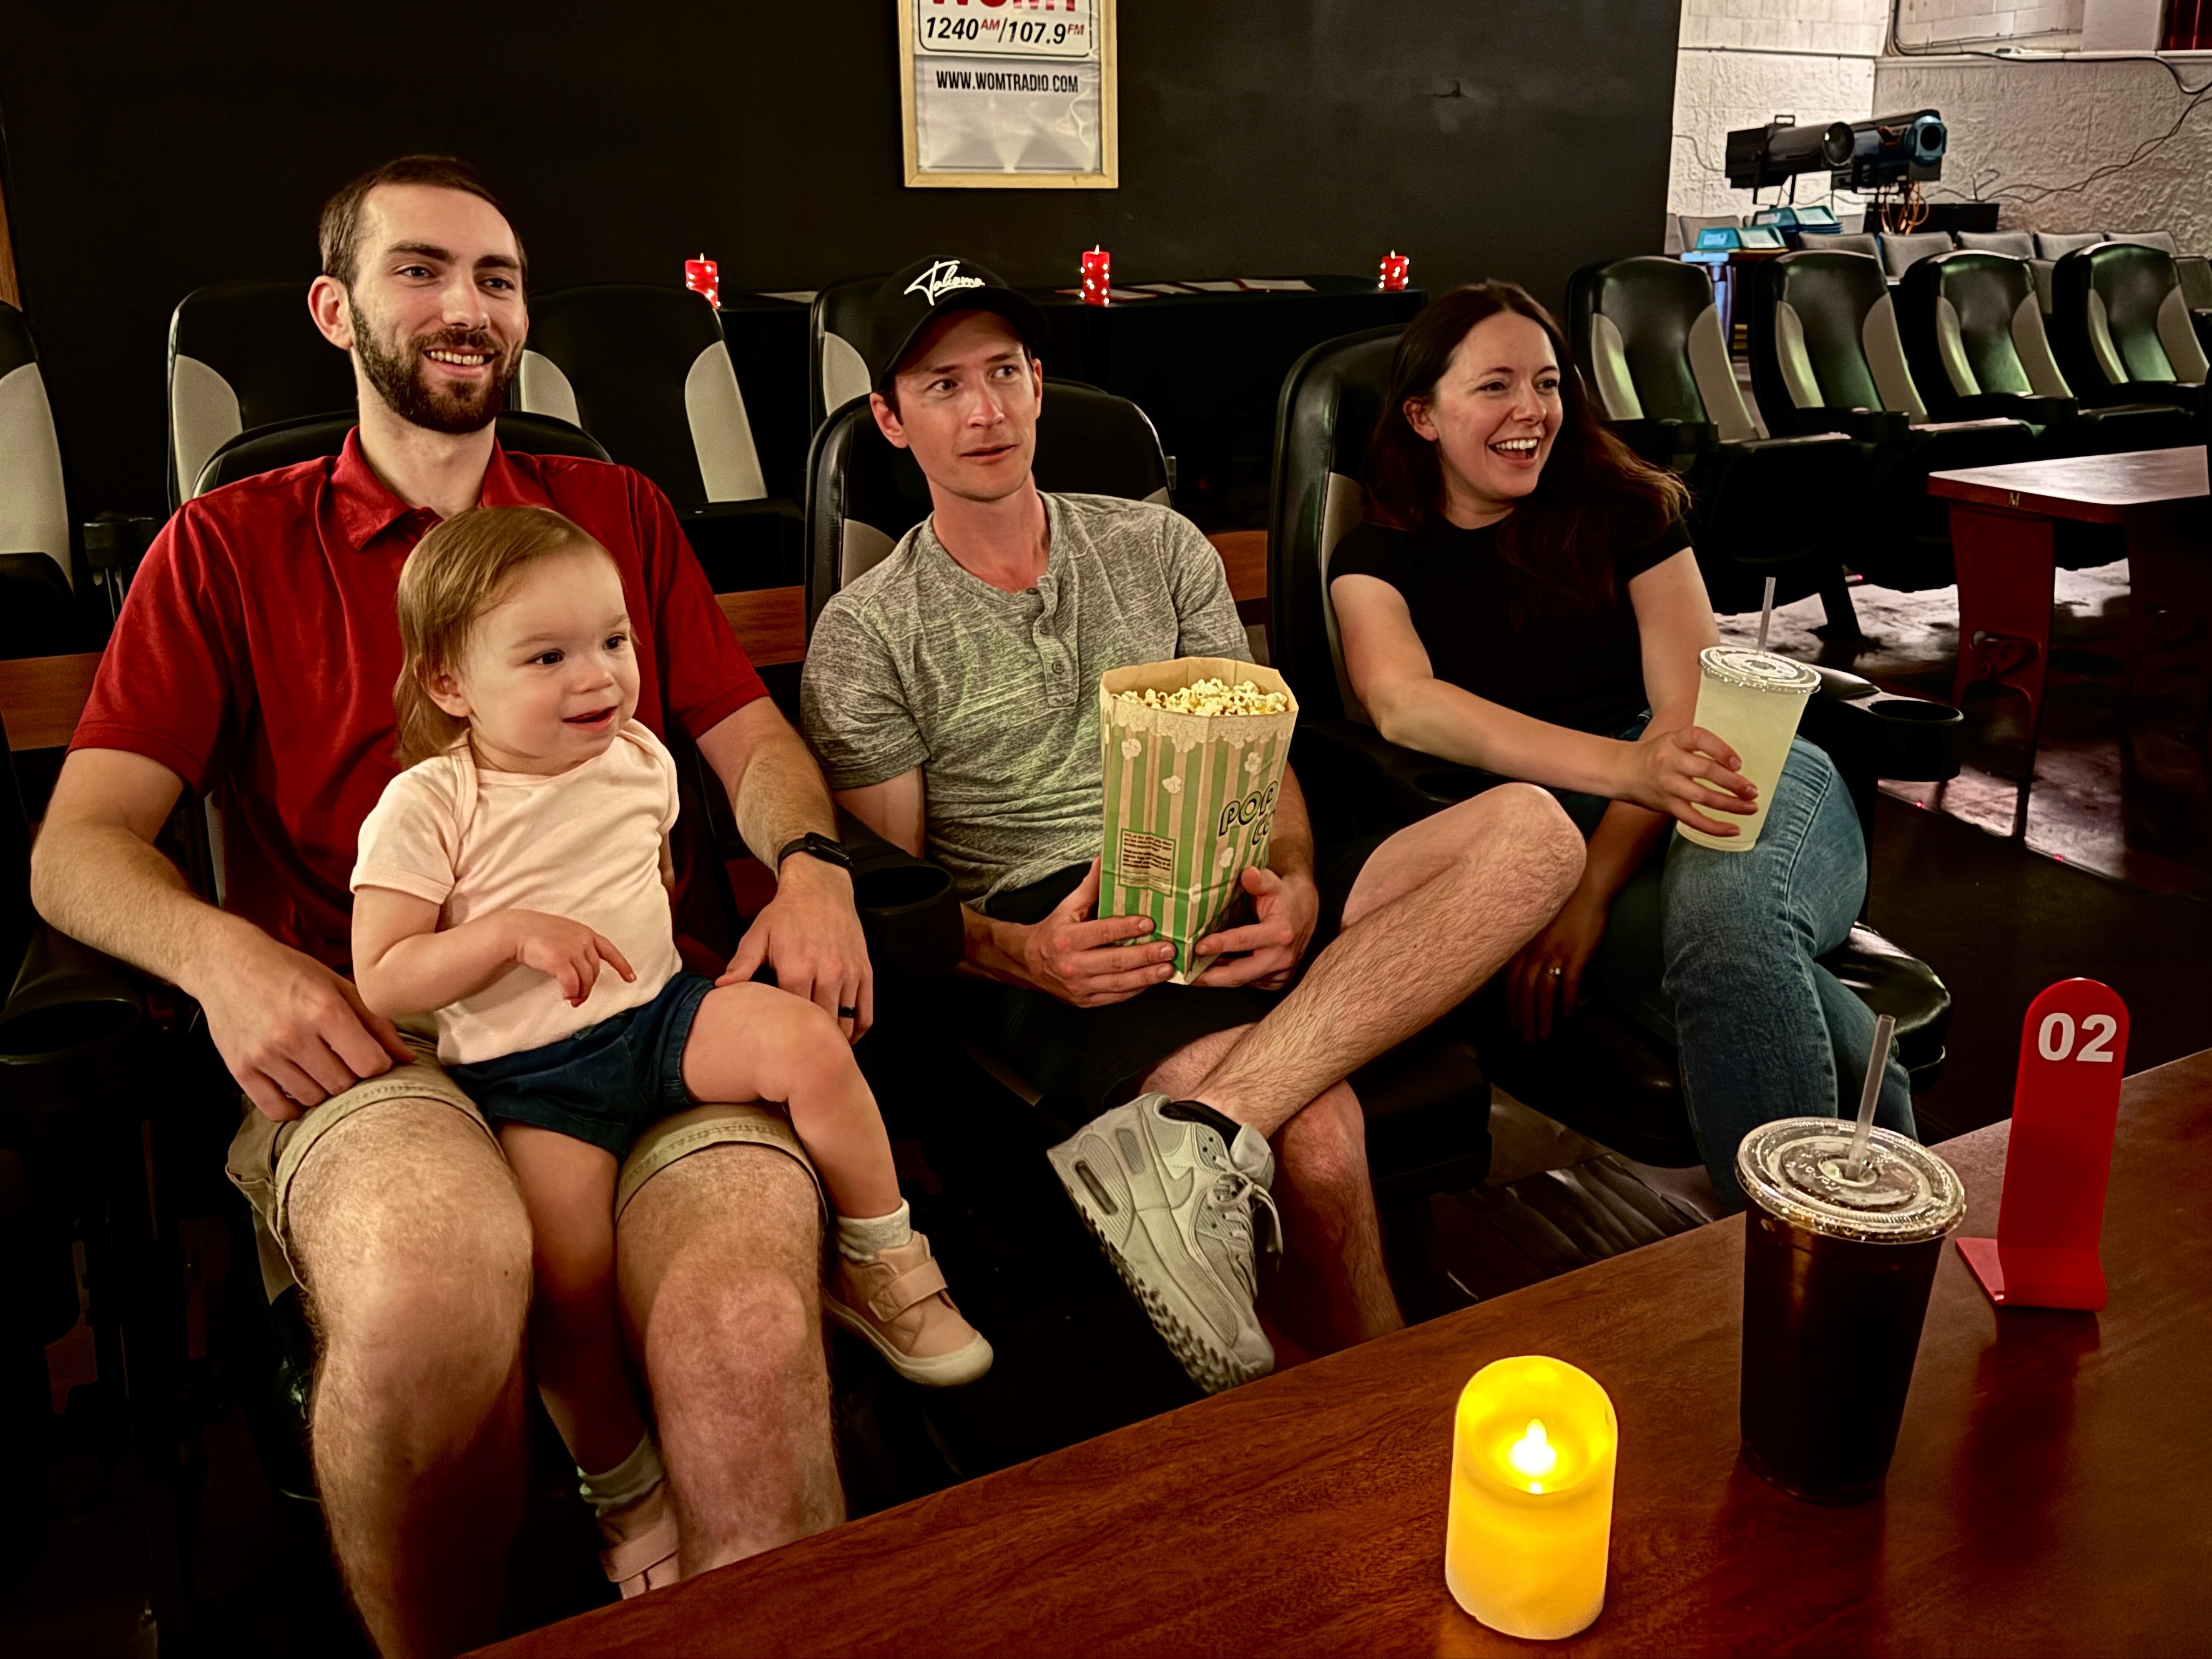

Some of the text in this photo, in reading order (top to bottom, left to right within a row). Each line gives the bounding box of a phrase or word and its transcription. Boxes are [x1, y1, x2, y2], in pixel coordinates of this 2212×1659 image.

[936, 71, 1079, 93] WWW.WOMTRADIO.COM
[1219, 780, 1278, 837] POP
[2038, 1012, 2117, 1062] 02
